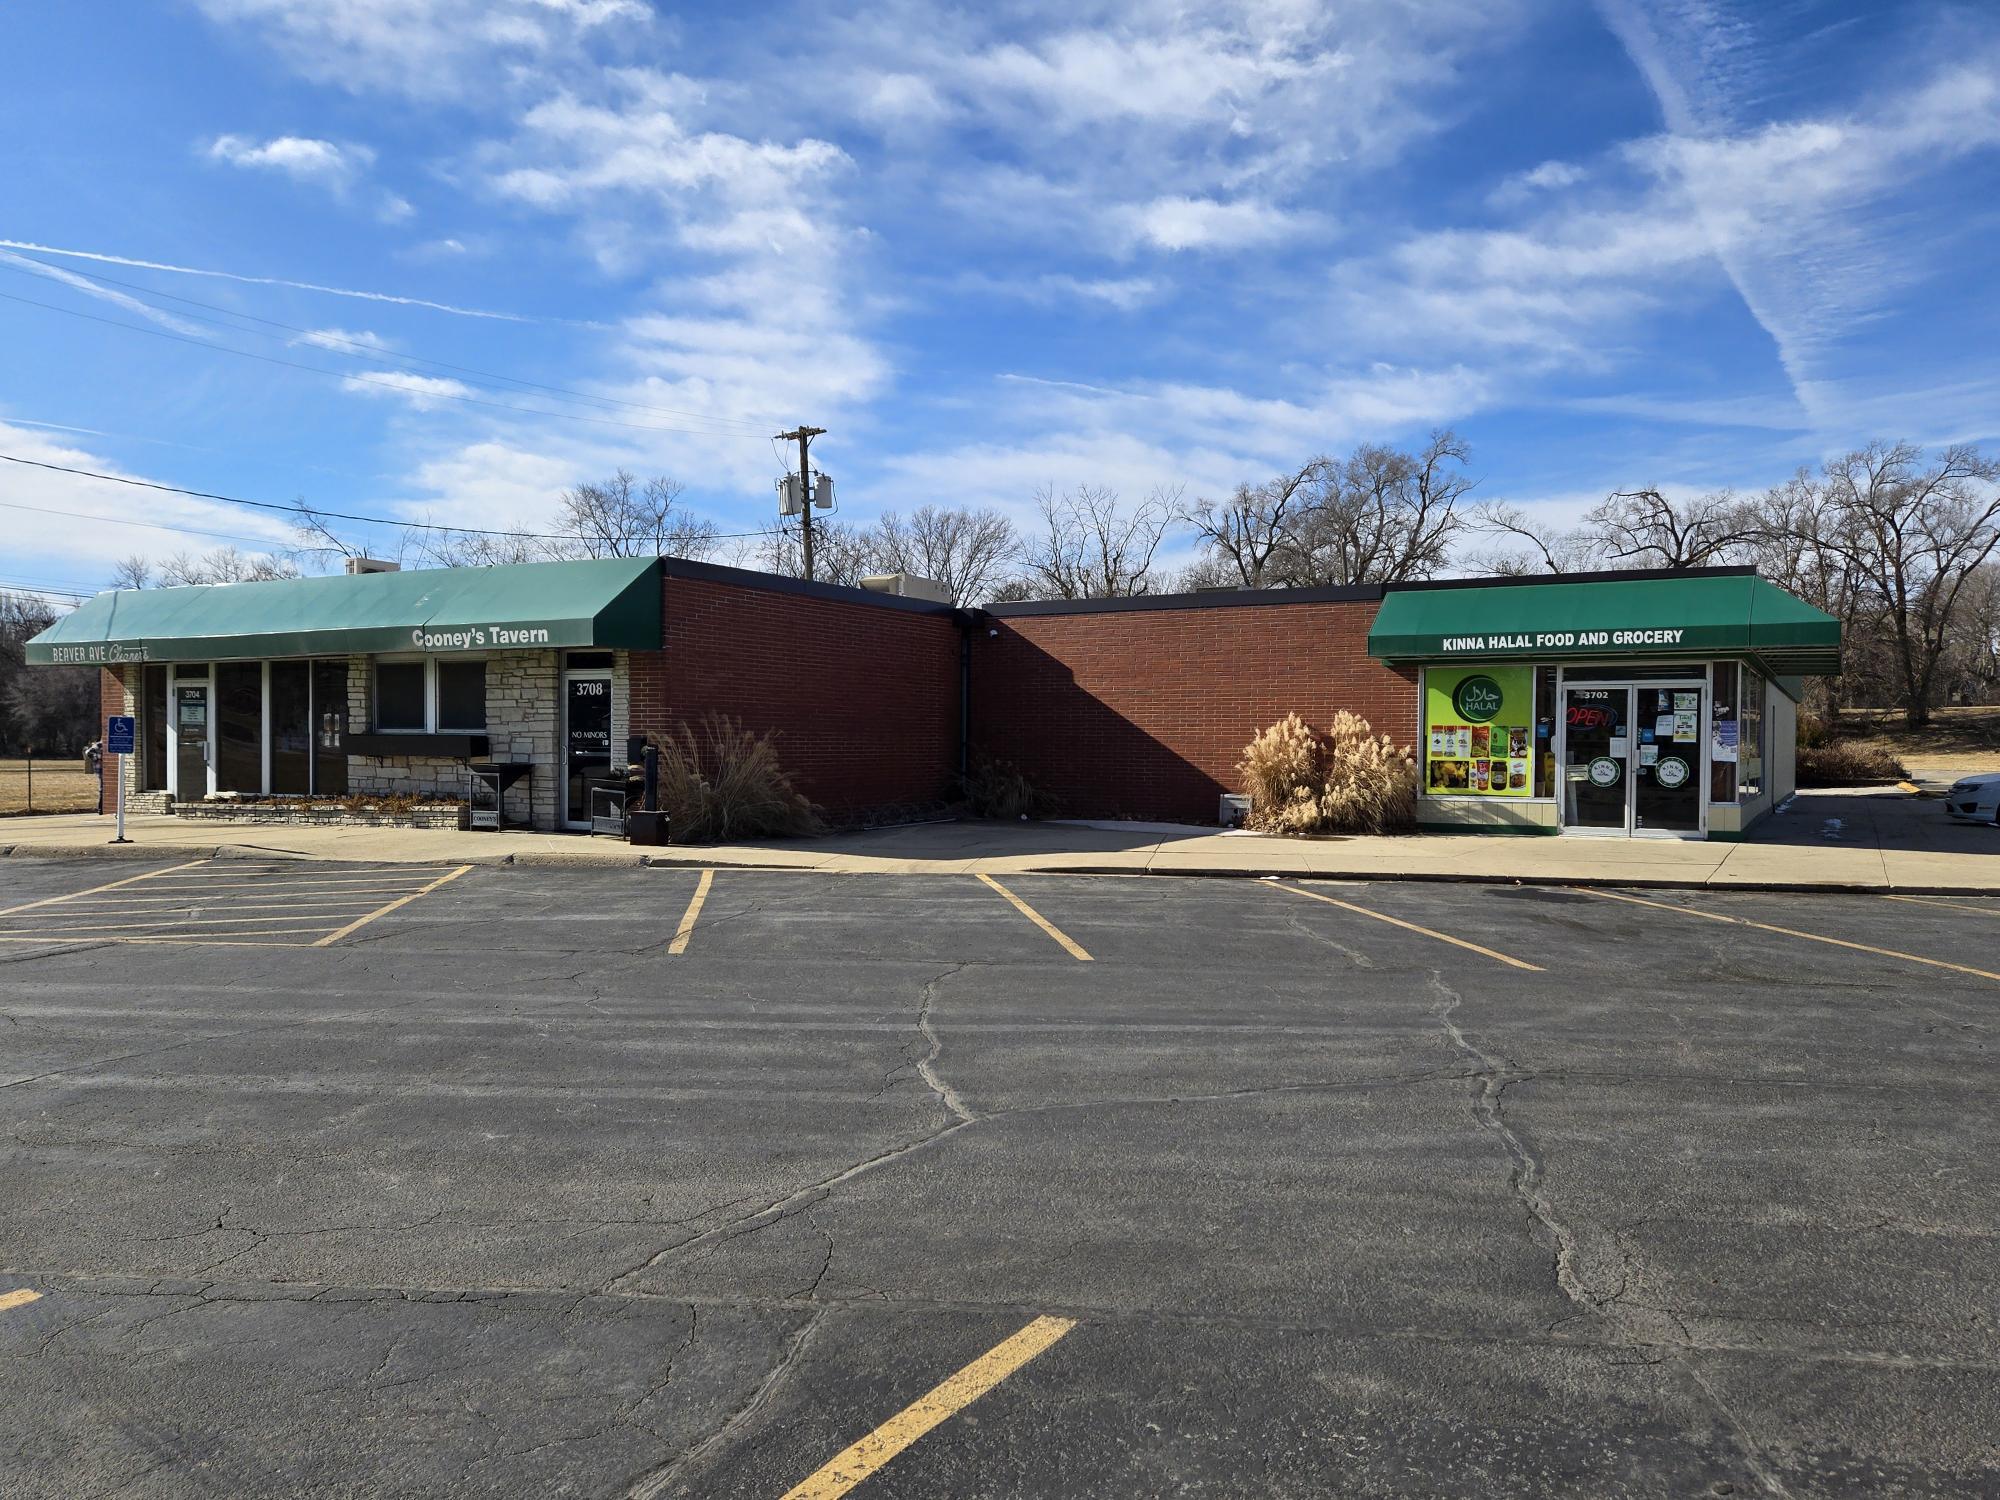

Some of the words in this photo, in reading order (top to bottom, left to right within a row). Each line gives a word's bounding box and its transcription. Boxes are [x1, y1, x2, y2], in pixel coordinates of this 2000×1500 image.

[412, 628, 485, 648] Cooney's
[489, 627, 549, 643] Tavern
[1443, 637, 1485, 651] KINNA
[1488, 635, 1533, 649] HALAL
[1536, 633, 1575, 647] FOOD
[1578, 632, 1609, 645] AND
[1612, 630, 1683, 644] GROCERY
[53, 647, 85, 662] BEAVER
[89, 646, 106, 661] AVE
[185, 690, 200, 698] 3704
[576, 683, 603, 695] 3708
[1466, 686, 1499, 701] حلال
[1584, 691, 1608, 699] 3702
[1466, 702, 1498, 710] HALAL
[1567, 707, 1609, 727] OPEN
